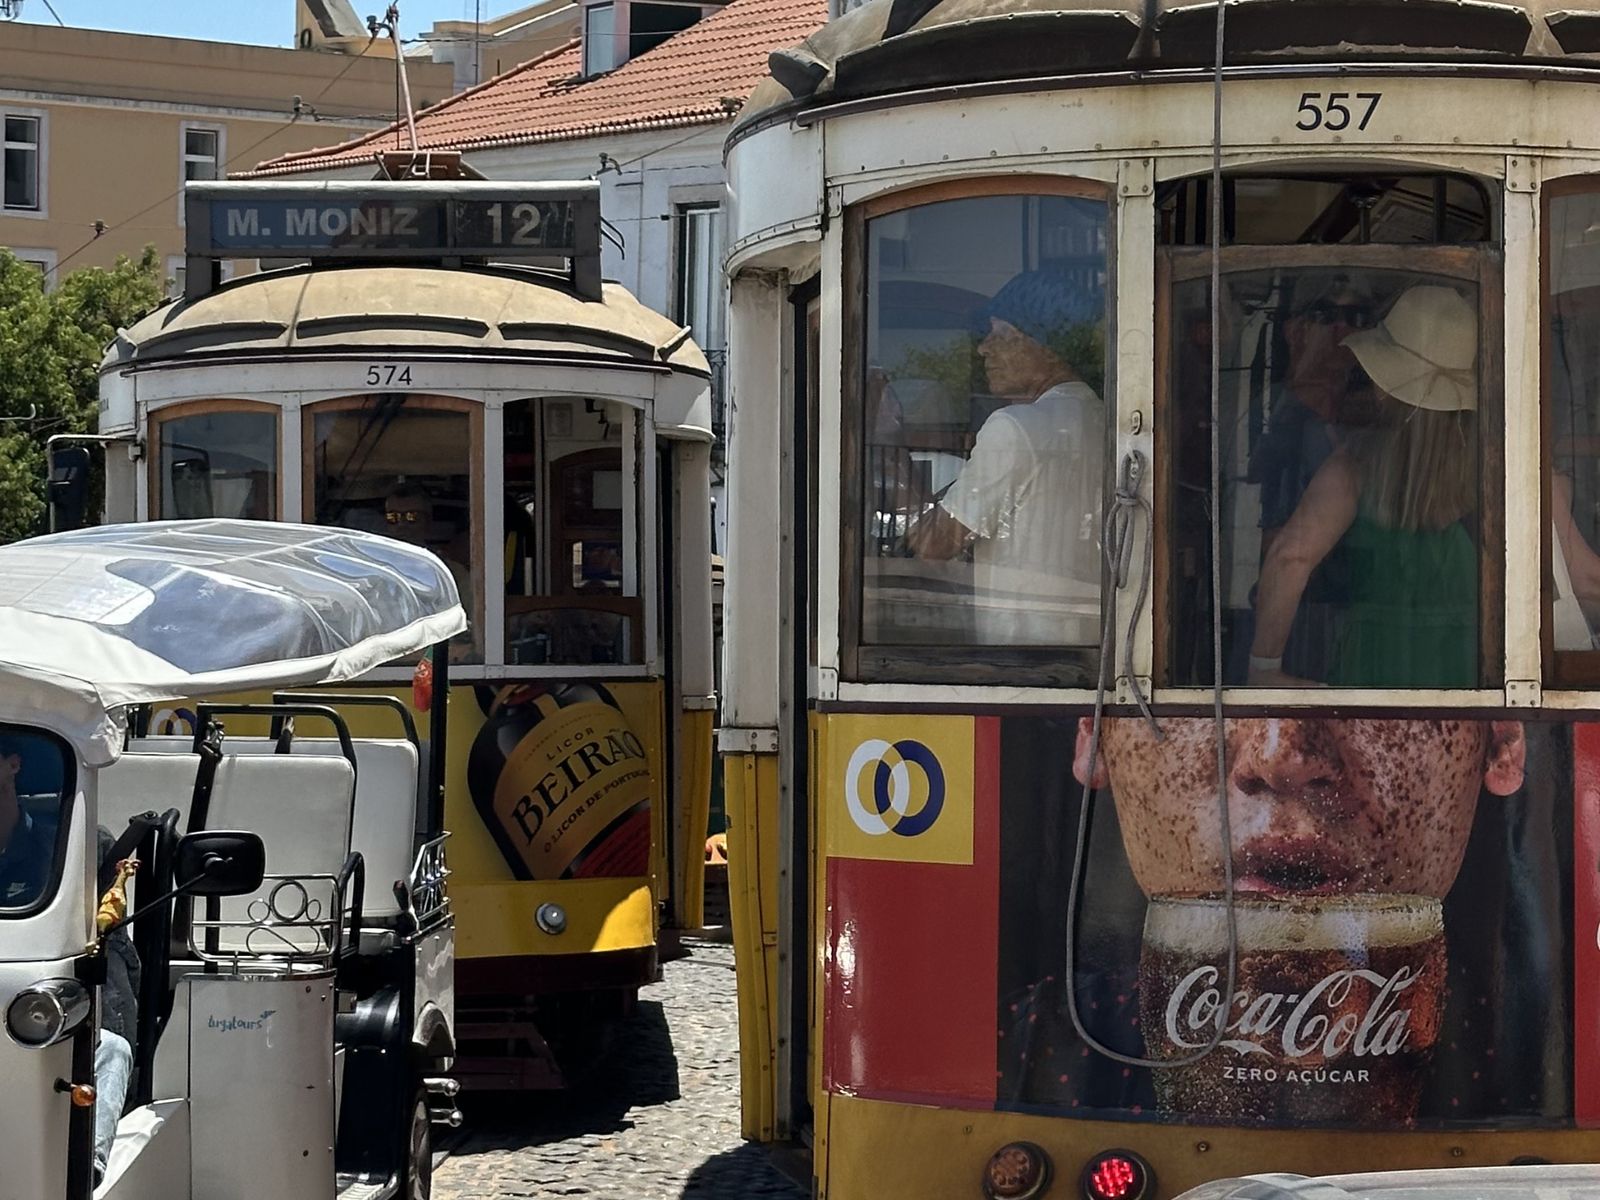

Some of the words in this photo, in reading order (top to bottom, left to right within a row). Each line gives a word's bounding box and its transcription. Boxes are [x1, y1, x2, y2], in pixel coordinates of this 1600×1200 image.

[1295, 92, 1383, 131] 557
[226, 208, 271, 236] M.
[285, 207, 419, 236] MONIZ
[487, 202, 541, 246] 12
[366, 365, 412, 386] 574
[546, 727, 595, 760] LICOR
[511, 728, 646, 846] BEIRÃO
[585, 791, 604, 807] DE
[1165, 964, 1426, 1058] Coca-Cola
[1223, 1066, 1277, 1082] ZERO
[1286, 1066, 1370, 1086] AÇÚCAR
